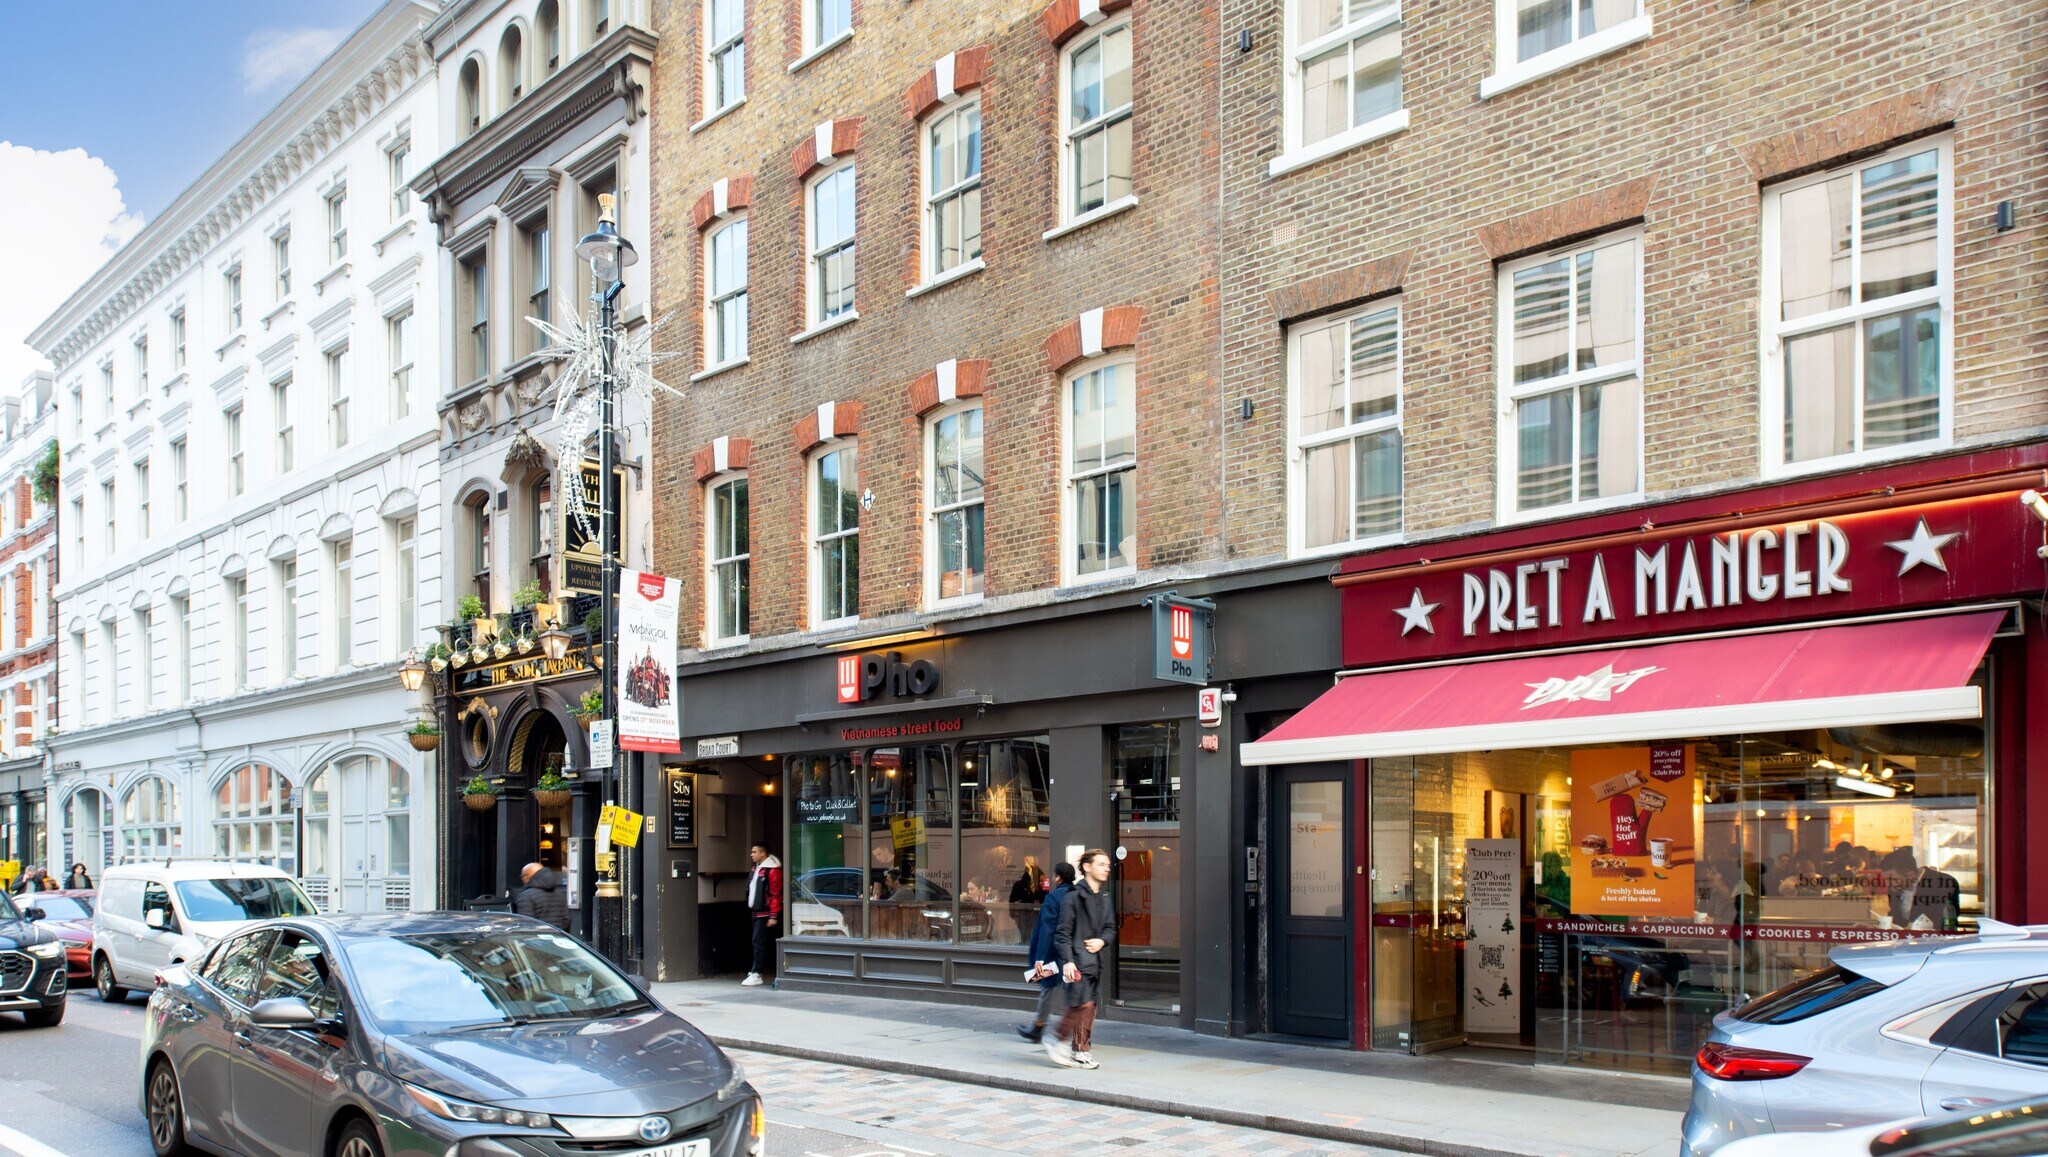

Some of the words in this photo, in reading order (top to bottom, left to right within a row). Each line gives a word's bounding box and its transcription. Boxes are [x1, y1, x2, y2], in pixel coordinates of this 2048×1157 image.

[584, 474, 600, 485] TH
[1463, 557, 1569, 637] PRET
[1582, 552, 1616, 624] A
[1634, 519, 1852, 618] MANGER
[629, 623, 668, 640] MONGOL
[1172, 660, 1192, 677] Pho
[861, 651, 939, 700] Pho
[1521, 664, 1668, 704] PRET
[841, 725, 898, 741] Vietnamese
[900, 720, 932, 736] street
[935, 717, 961, 732] food
[699, 744, 715, 756] BROAD
[716, 742, 731, 755] COURT
[1653, 750, 1669, 758] 20%
[1617, 815, 1635, 825] Hey,
[1616, 824, 1631, 832] Hot
[1616, 831, 1637, 841] Stuff
[1473, 849, 1493, 857] Club
[1473, 870, 1498, 881] 20%
[1500, 872, 1512, 881] off
[1606, 887, 1632, 897] Freshly
[1557, 922, 1626, 933] SANDWICHES
[1642, 924, 1715, 936] CAPPUCCINO
[1758, 928, 1811, 939] COOKIES
[1831, 930, 1899, 941] ESPRESSO
